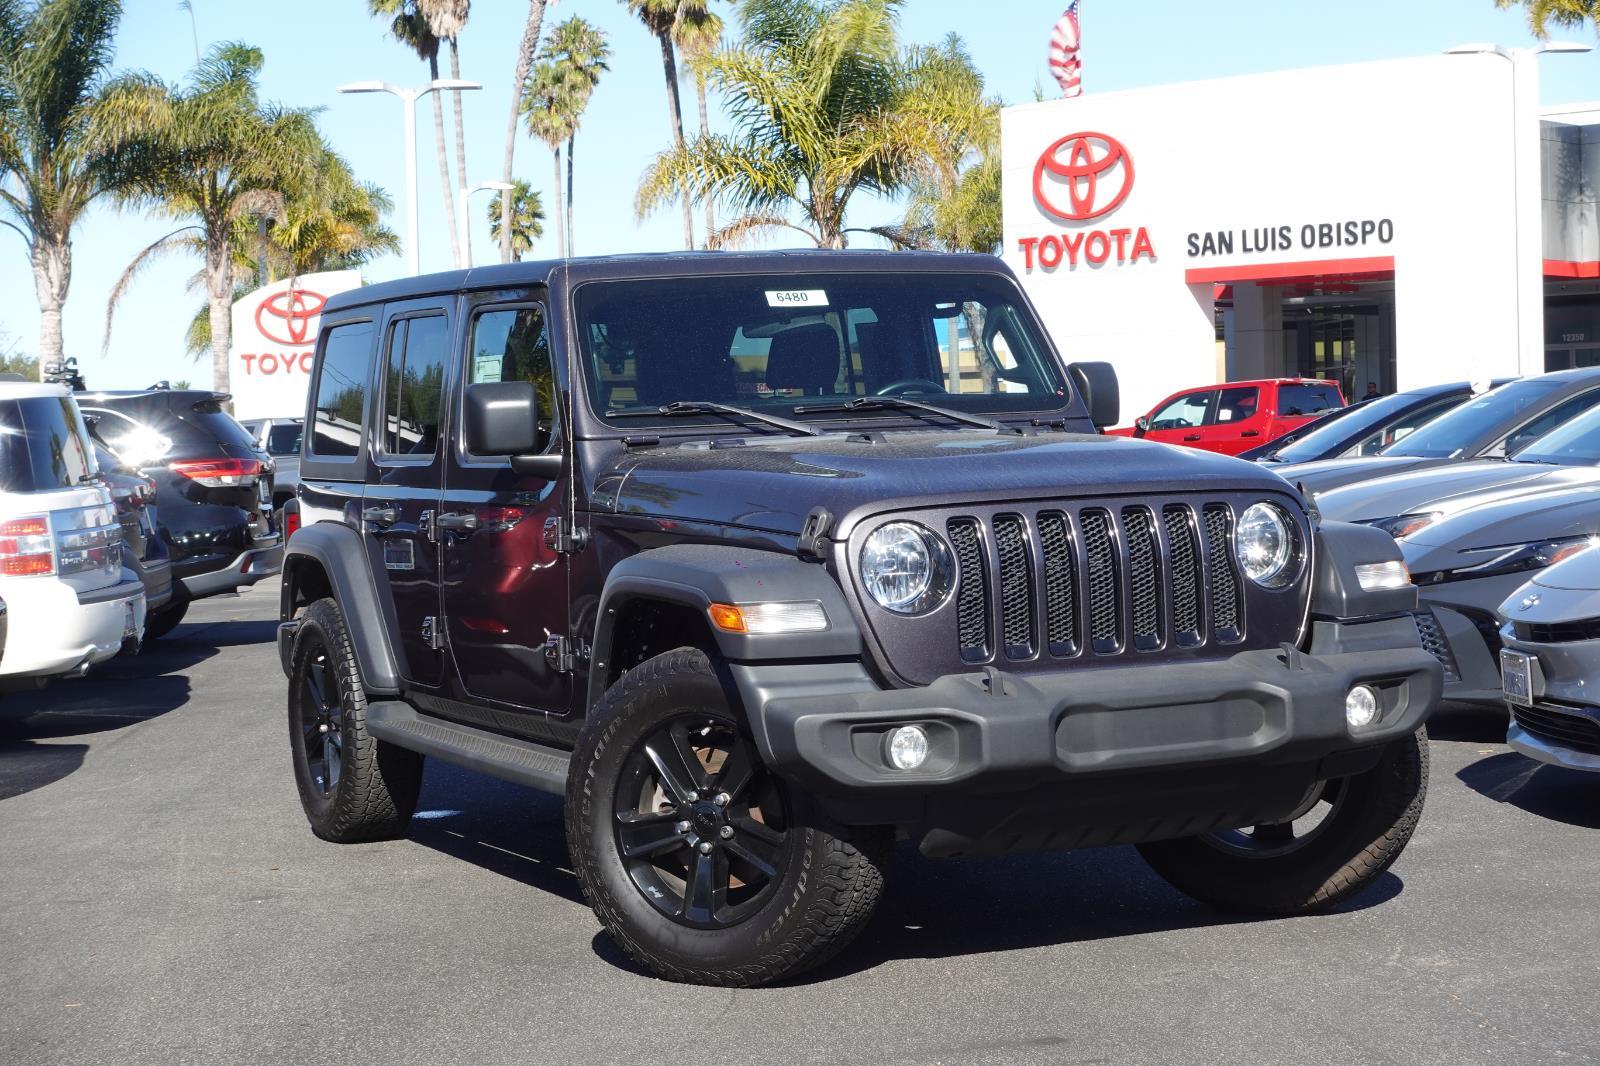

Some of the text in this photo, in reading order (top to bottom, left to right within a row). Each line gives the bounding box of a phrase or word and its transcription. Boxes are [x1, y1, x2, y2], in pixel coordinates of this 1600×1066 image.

[1018, 227, 1156, 270] TOYOTA
[1187, 218, 1394, 257] SAN LUIS OBISPO
[776, 292, 808, 302] 6480
[240, 352, 314, 375] TOYO
